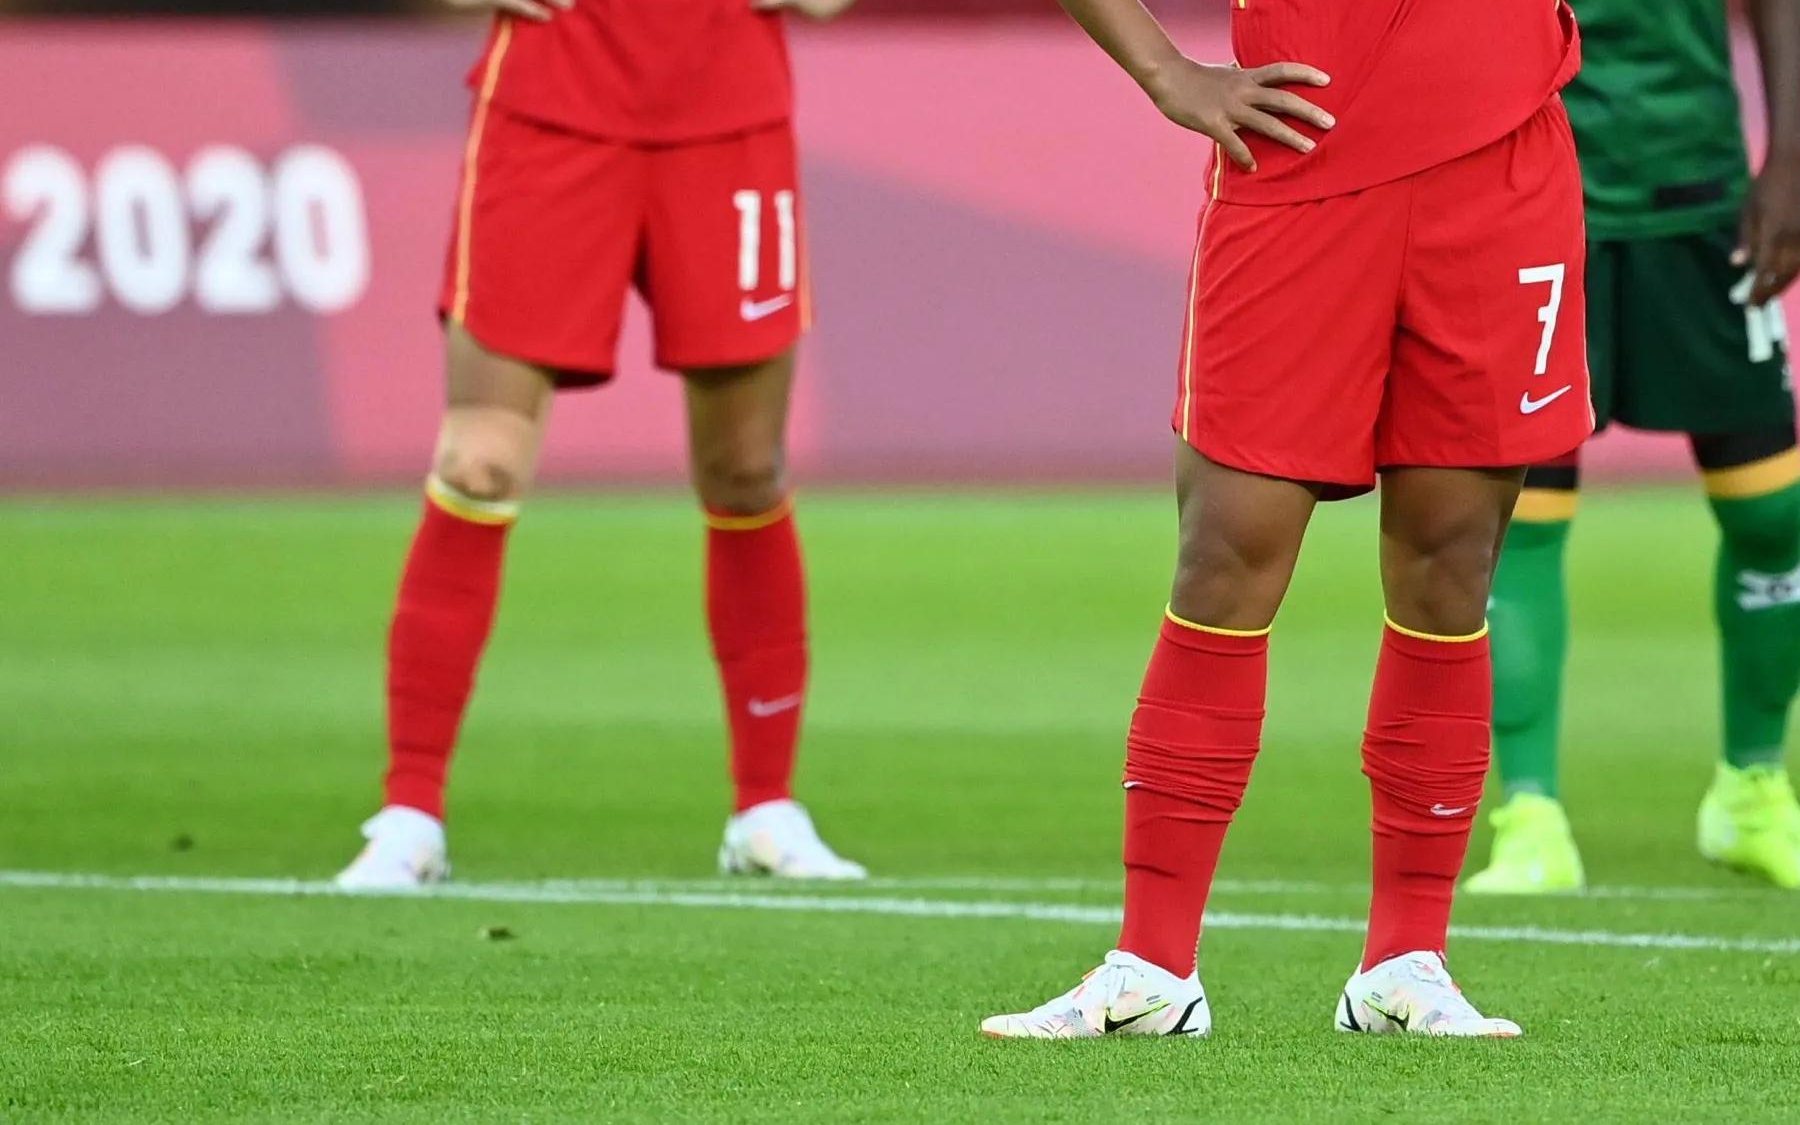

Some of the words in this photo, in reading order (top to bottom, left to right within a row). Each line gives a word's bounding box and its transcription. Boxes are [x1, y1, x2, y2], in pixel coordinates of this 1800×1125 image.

[4, 143, 370, 315] 2020
[733, 189, 795, 291] 11
[1518, 263, 1565, 375] 7
